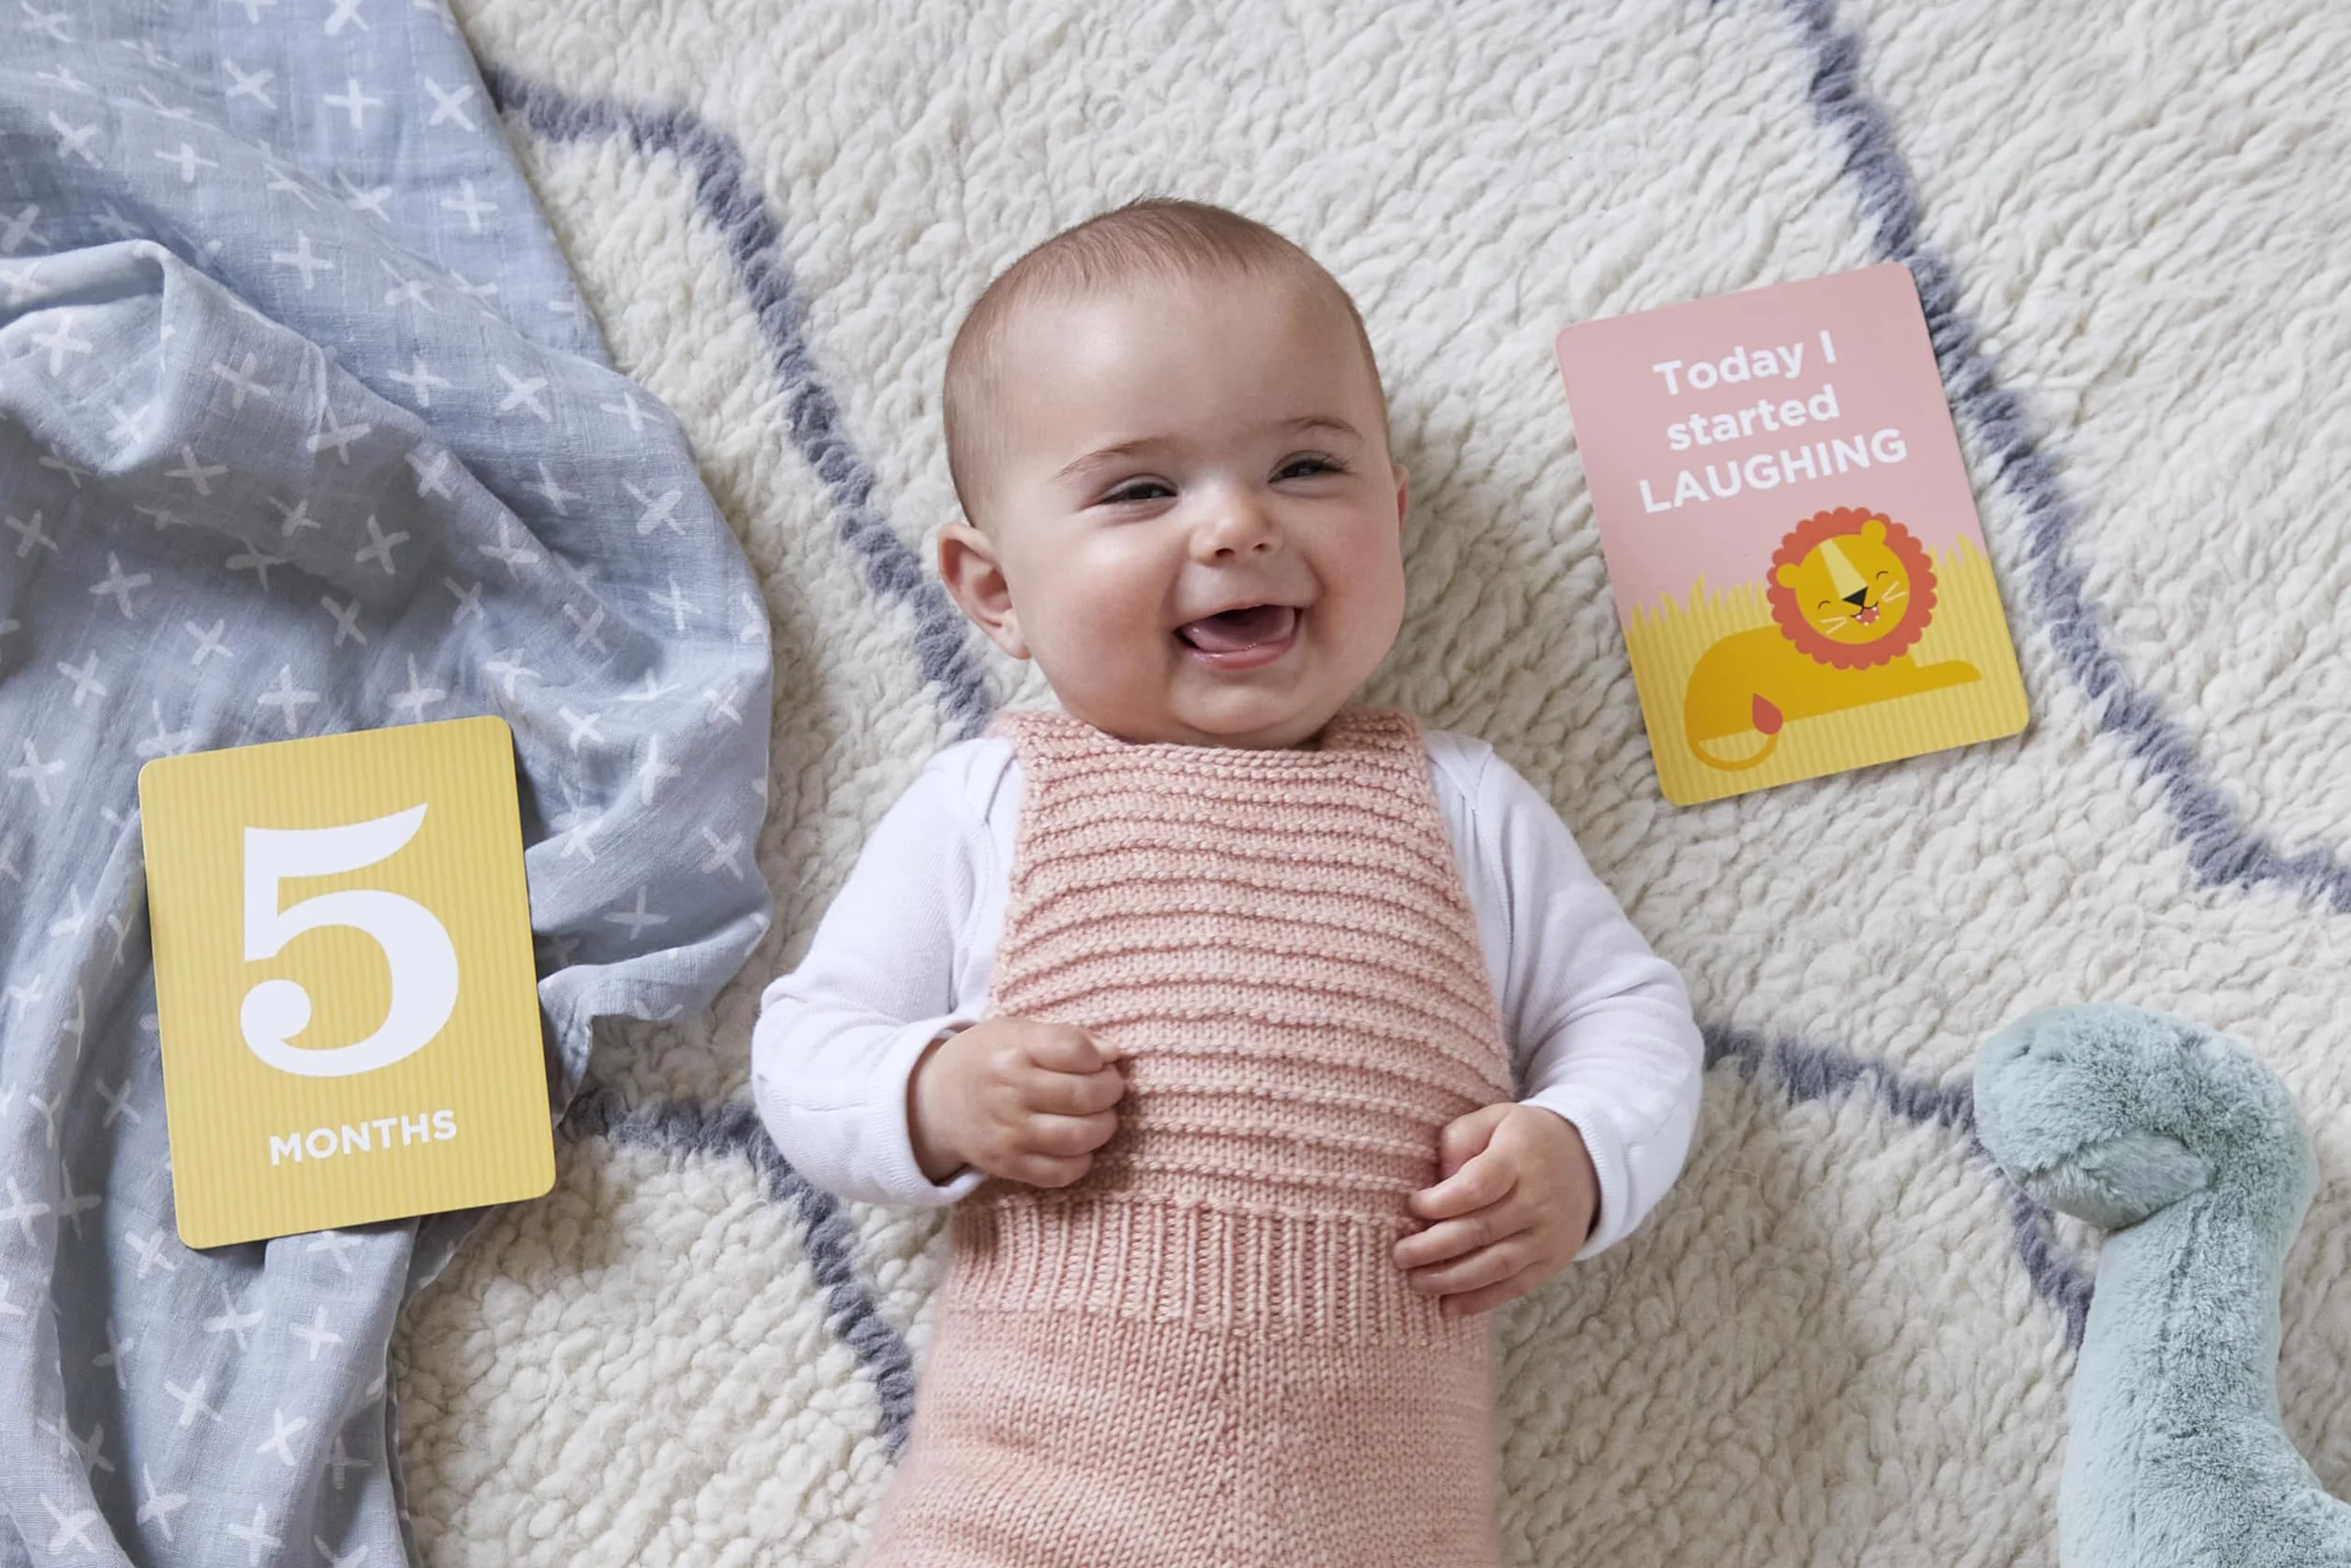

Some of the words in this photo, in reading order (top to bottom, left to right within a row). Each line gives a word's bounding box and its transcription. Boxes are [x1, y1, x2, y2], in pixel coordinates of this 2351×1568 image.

[1651, 342, 1804, 395] Today
[1819, 330, 1837, 363] I
[1666, 383, 1841, 451] started
[1639, 428, 1908, 513] LAUGHING
[239, 802, 460, 1078] 5
[269, 1109, 458, 1166] MONTHS
